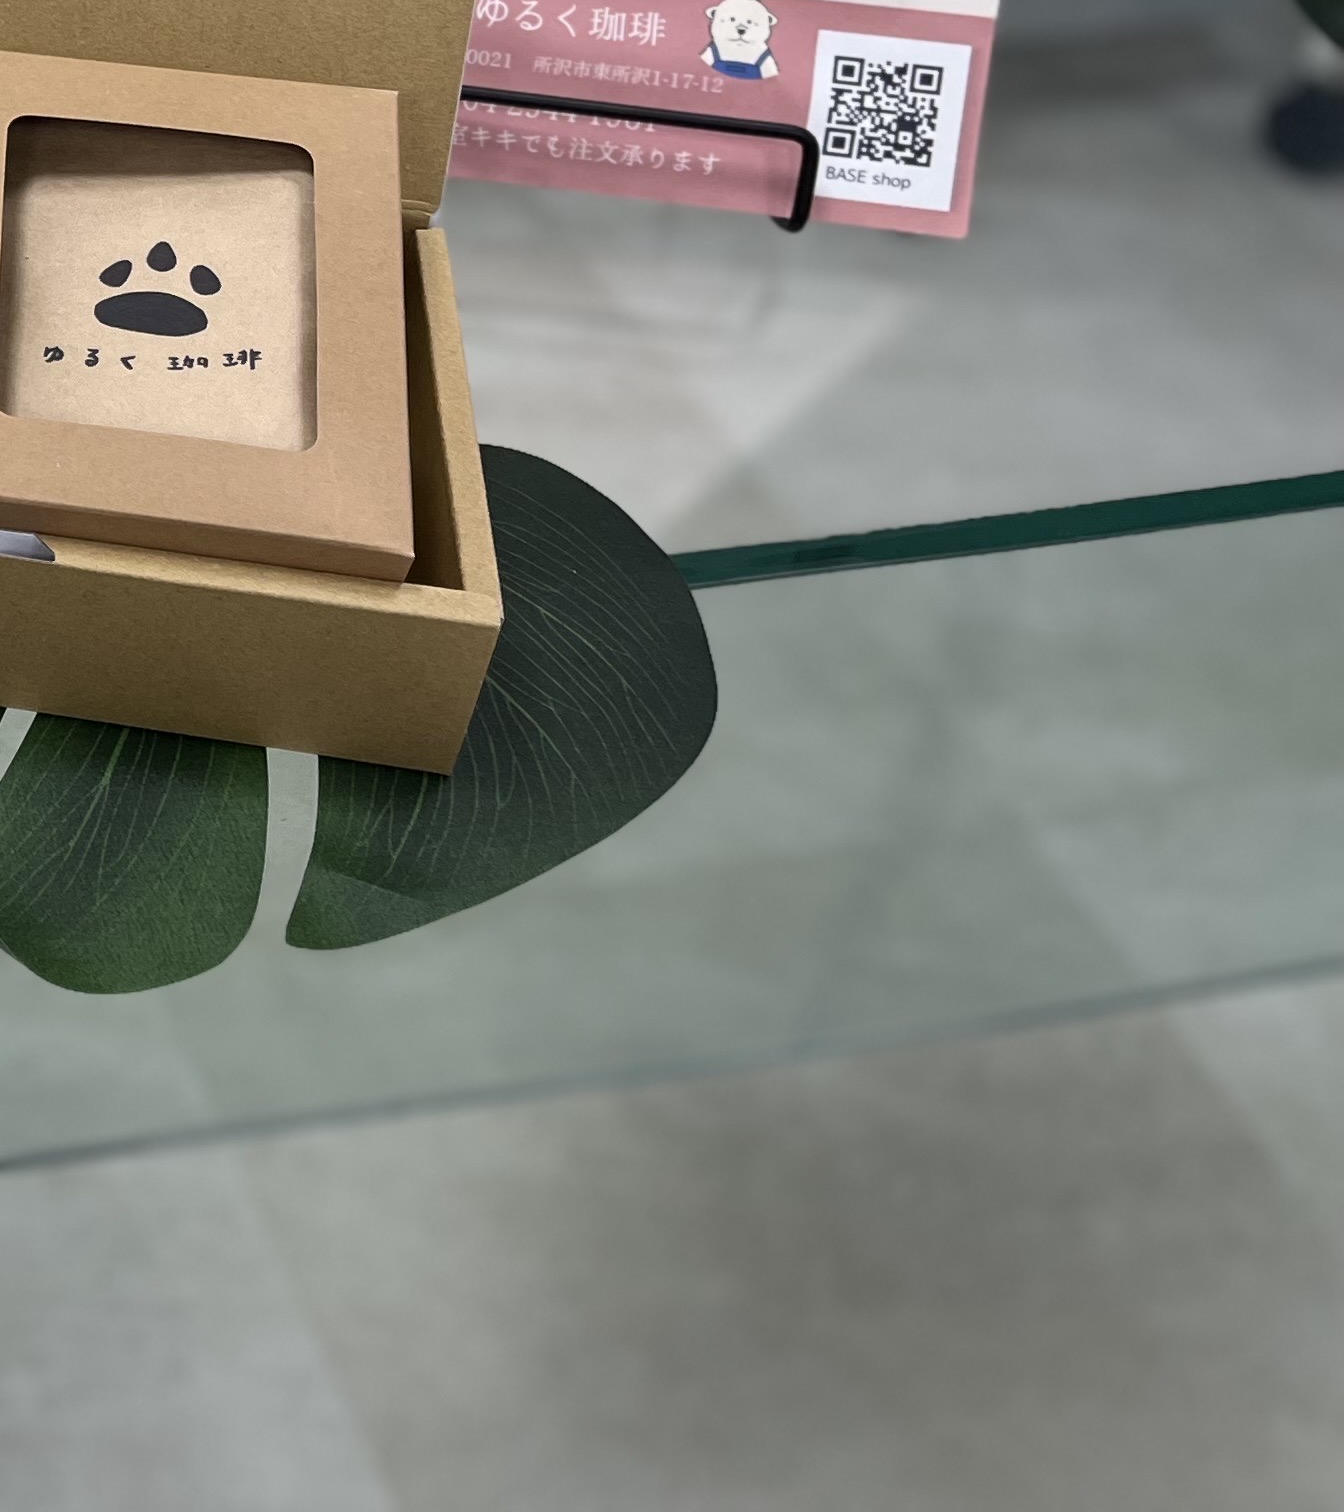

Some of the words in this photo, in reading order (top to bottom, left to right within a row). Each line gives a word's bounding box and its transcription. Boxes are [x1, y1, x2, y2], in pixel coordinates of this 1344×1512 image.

[531, 54, 724, 94] 所沢市東所沢1-17-12
[825, 165, 868, 185] BASE
[872, 172, 913, 192] shop
[42, 345, 263, 371] ゆるく珈琲
